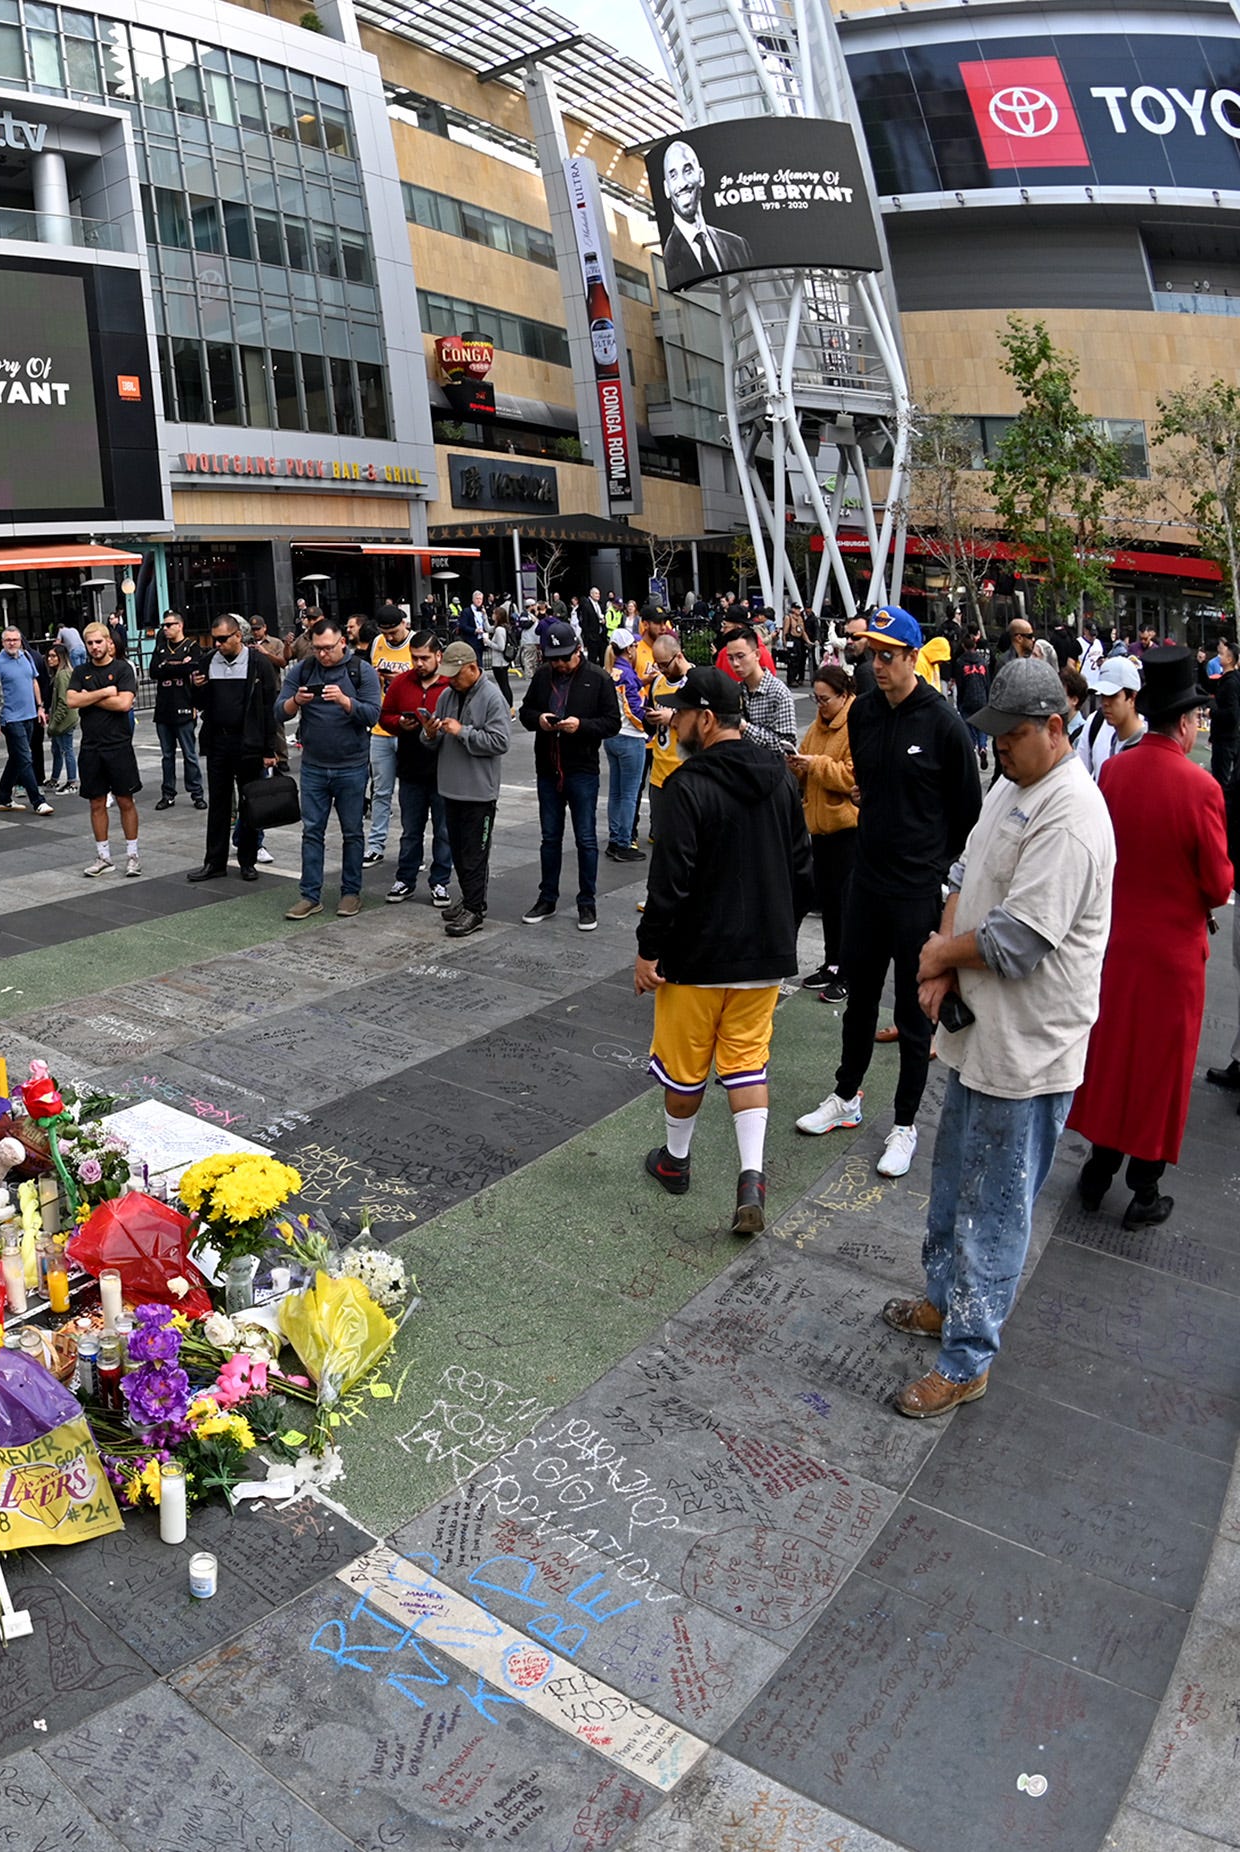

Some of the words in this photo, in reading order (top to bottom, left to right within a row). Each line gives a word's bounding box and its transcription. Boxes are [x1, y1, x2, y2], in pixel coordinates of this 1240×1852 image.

[1089, 85, 1240, 139] TOYO
[570, 161, 586, 204] ULTRA
[714, 185, 767, 207] KOBE
[771, 184, 853, 203] BRYANT
[720, 175, 734, 189] In
[736, 171, 770, 186] Loving
[773, 169, 820, 184] Memory
[822, 171, 840, 185] Of
[761, 202, 781, 210] 1978
[788, 201, 809, 210] 2020
[25, 357, 52, 379] Of
[442, 348, 491, 362] CONGA
[602, 386, 622, 434] CONGA
[184, 453, 277, 474] WOLFGANG
[286, 458, 325, 477] PUCK
[331, 461, 360, 480] BAR
[384, 465, 422, 484] GRILL
[608, 437, 626, 479] ROOM
[656, 723, 671, 751] 8
[533, 1457, 606, 1512] GIGI
[667, 1478, 713, 1515] RIP
[691, 1469, 733, 1514] KOBE
[66, 1503, 110, 1524] #24
[793, 1489, 821, 1522] RIP
[530, 1552, 563, 1593] THANK
[778, 1538, 801, 1592] NEVER
[456, 1572, 641, 1724] KOBE
[598, 1625, 647, 1671] RIP
[543, 1674, 602, 1702] RIP
[52, 1726, 105, 1768] RIP
[60, 1816, 86, 1843] in
